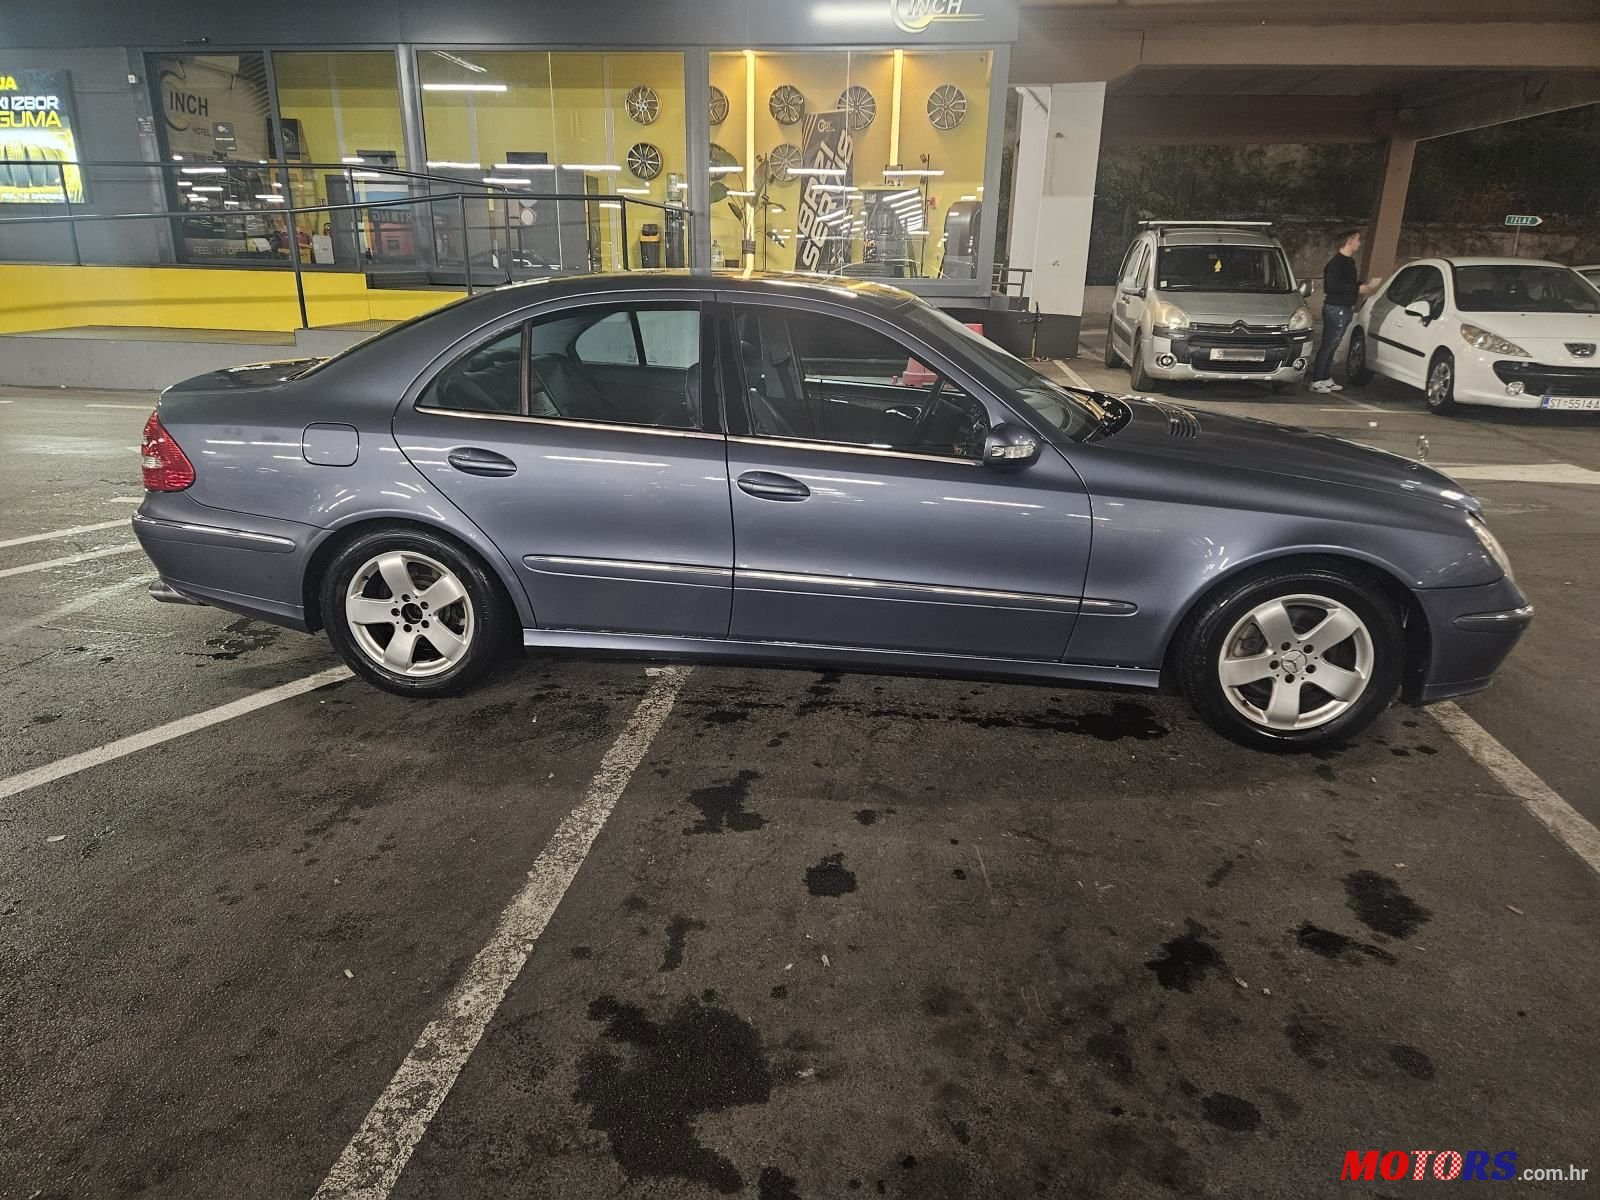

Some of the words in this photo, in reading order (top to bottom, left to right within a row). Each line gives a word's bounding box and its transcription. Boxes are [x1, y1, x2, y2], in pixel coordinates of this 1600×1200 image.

[909, 0, 962, 16] INCH
[11, 95, 60, 111] IZBOR
[170, 91, 209, 117] INCH
[0, 110, 62, 128] GUMA
[1550, 398, 1562, 408] ST
